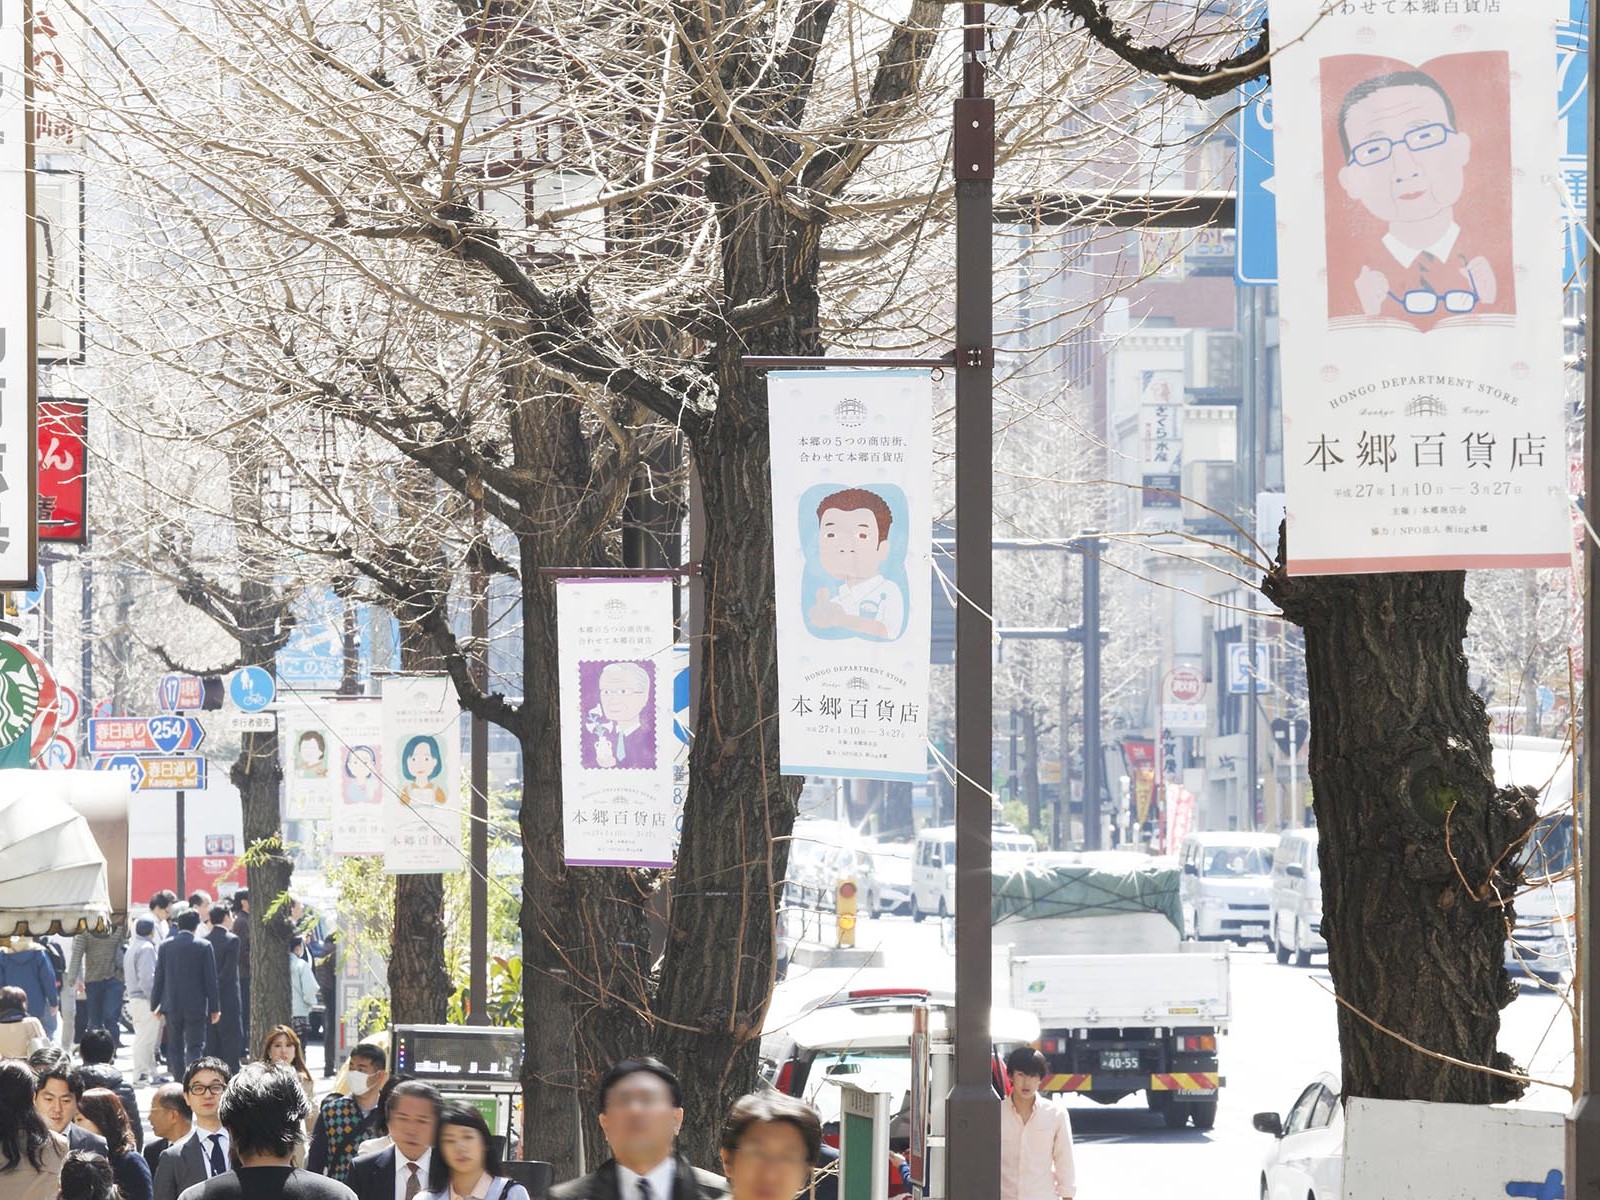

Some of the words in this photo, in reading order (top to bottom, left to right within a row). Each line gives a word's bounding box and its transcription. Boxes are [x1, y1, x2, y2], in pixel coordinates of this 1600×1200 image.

[1330, 383, 1377, 409] HONGO
[1381, 375, 1475, 390] DEPARTMENT
[1477, 383, 1519, 407] STORE
[1303, 430, 1548, 473] 本郷百貨店
[804, 667, 831, 682] HONGO
[833, 664, 884, 675] DEPARTMENT
[886, 672, 907, 687] STORE
[166, 680, 178, 702] 17
[790, 694, 919, 725] 本郷百貨店
[95, 722, 147, 739] 春日通り
[152, 720, 182, 739] 254
[148, 761, 198, 777] 春日通り
[572, 808, 667, 828] 本郷百貨店
[1108, 1057, 1140, 1069] 40-55
